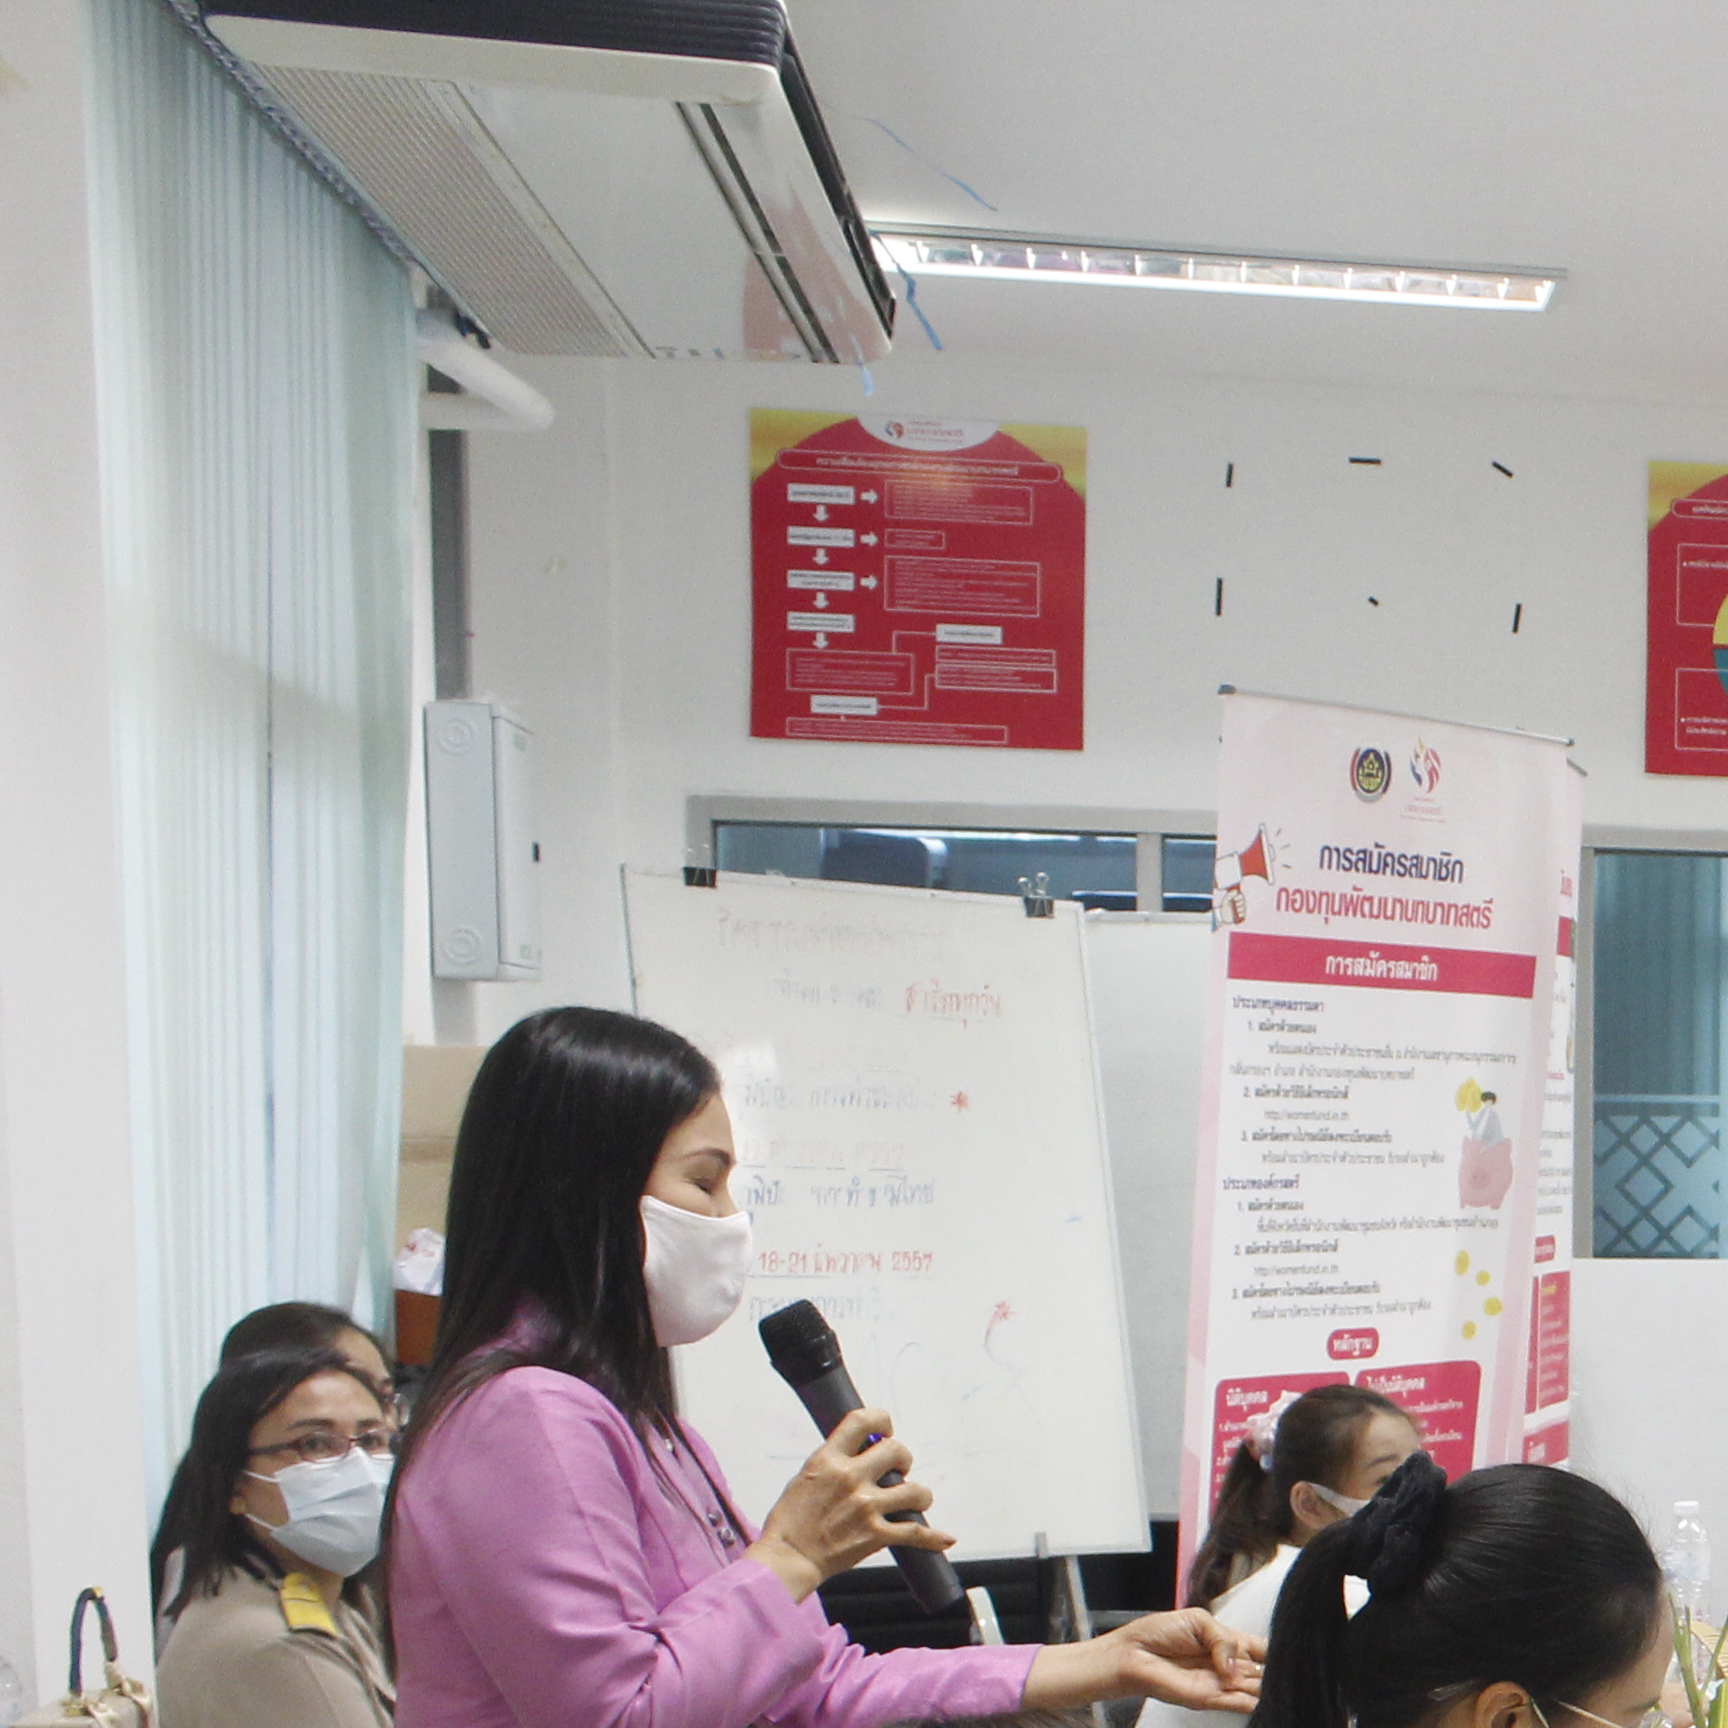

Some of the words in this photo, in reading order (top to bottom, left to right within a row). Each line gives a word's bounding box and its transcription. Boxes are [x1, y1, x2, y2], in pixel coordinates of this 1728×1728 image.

[1319, 842, 1463, 884] การสมัครสมาชิก
[1276, 886, 1494, 930] กองทุนพัฒนาบทบาทสตรี
[1325, 951, 1438, 983] การสมัครสมาชิก
[1232, 995, 1324, 1014] ประเภทบุคคลธรรมดา
[758, 1253, 807, 1274] 18-21
[891, 1251, 933, 1272] 2557
[1332, 1334, 1373, 1355] หลักฐาน
